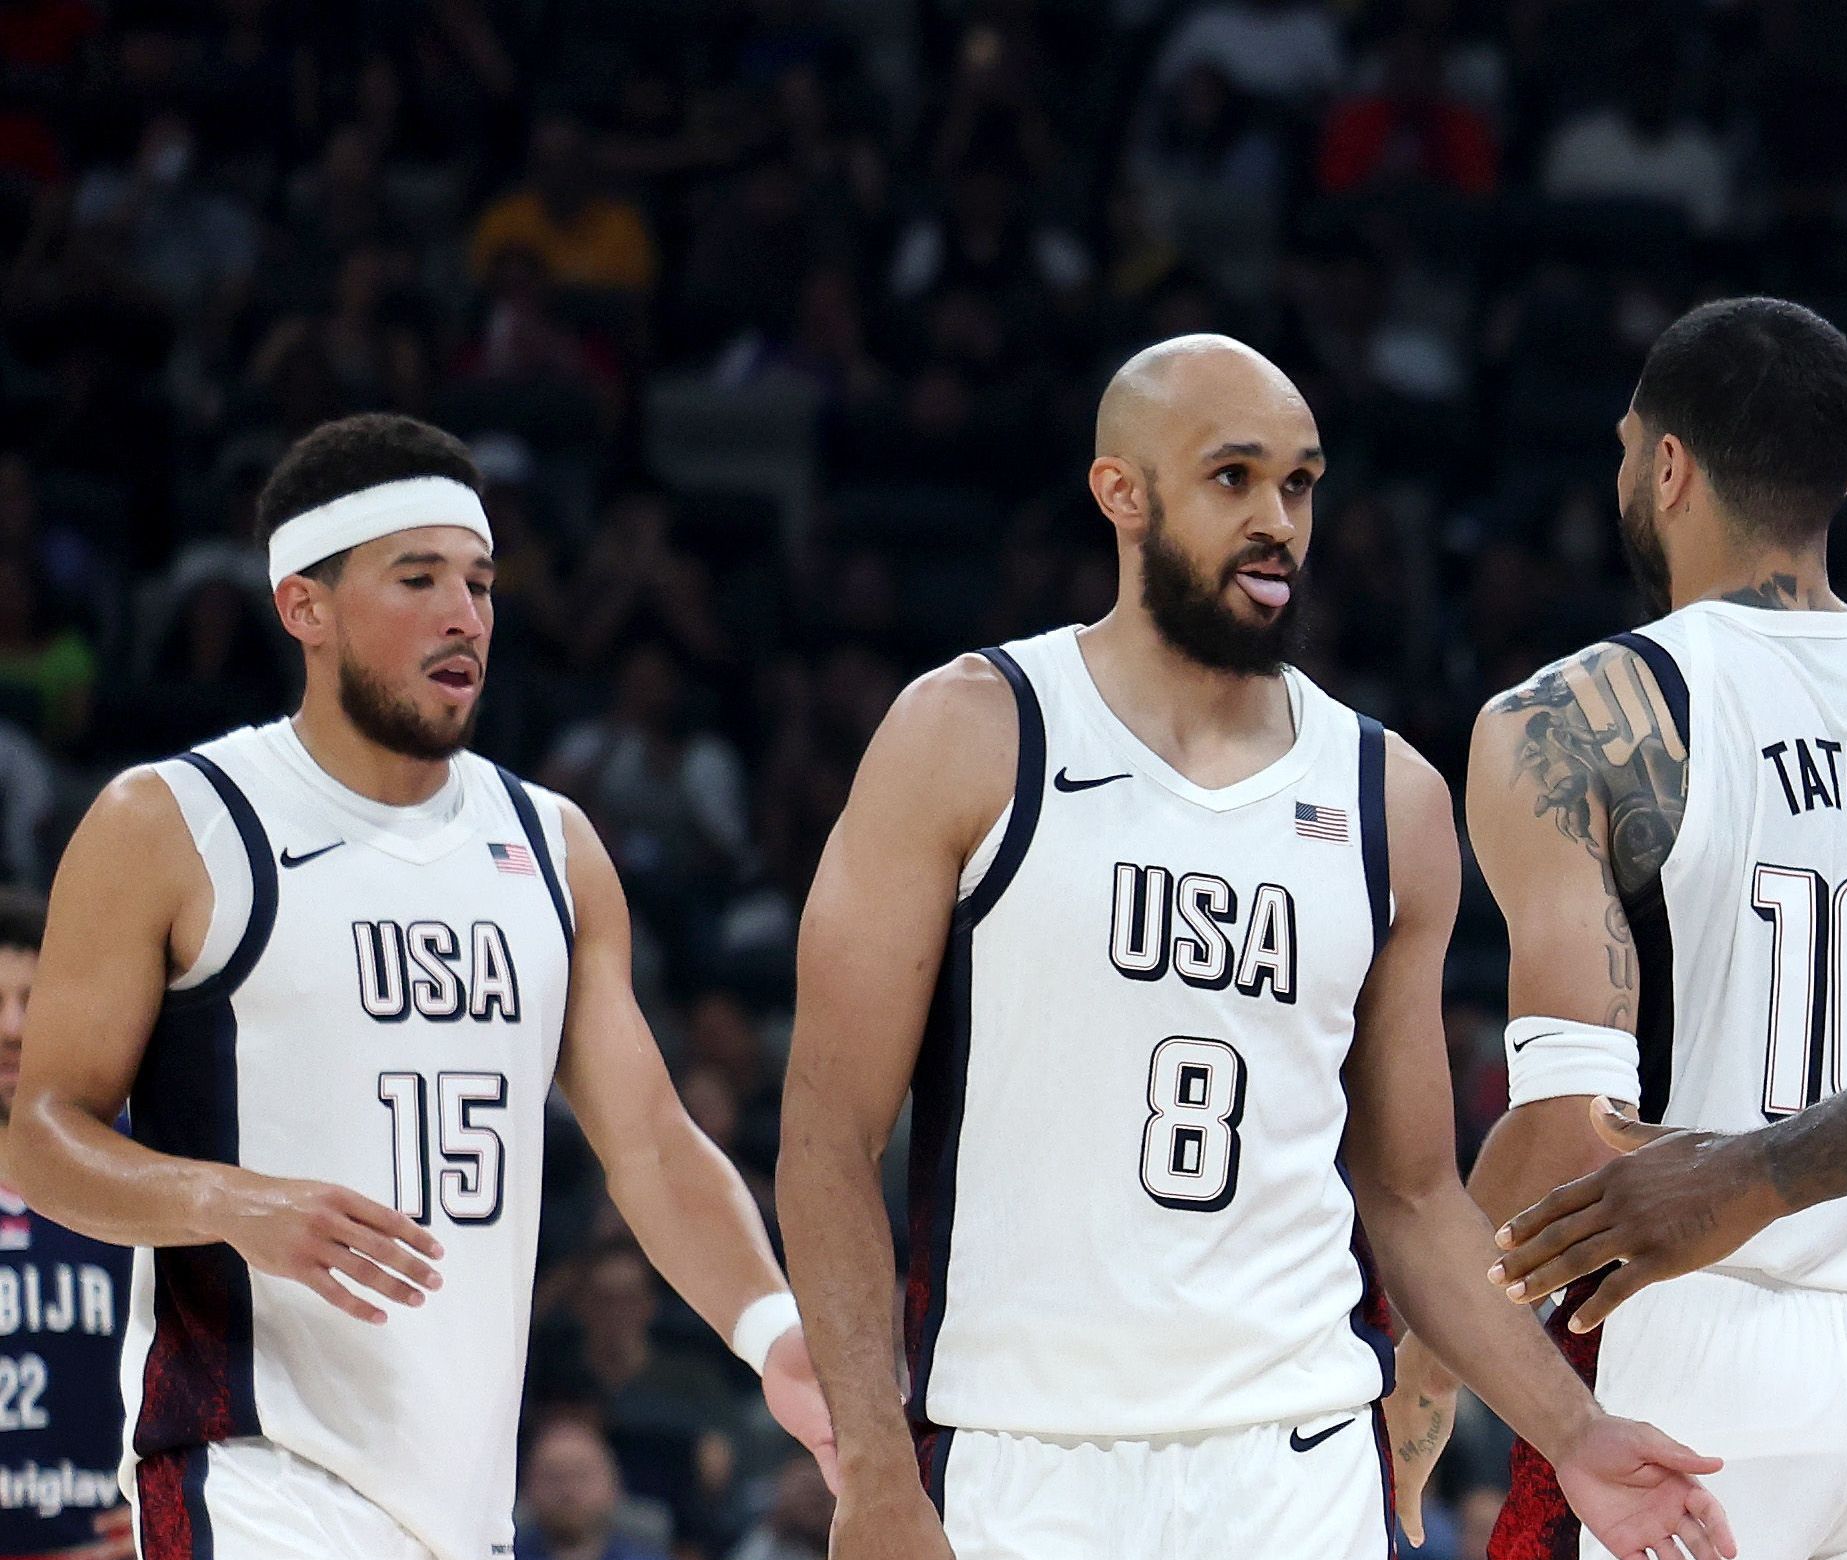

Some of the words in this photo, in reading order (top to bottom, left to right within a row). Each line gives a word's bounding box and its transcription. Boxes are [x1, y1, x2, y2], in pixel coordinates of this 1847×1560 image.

[352, 920, 521, 1023] USA
[1108, 861, 1298, 1005] USA
[378, 1071, 508, 1226] 15
[1139, 1035, 1248, 1213] 8
